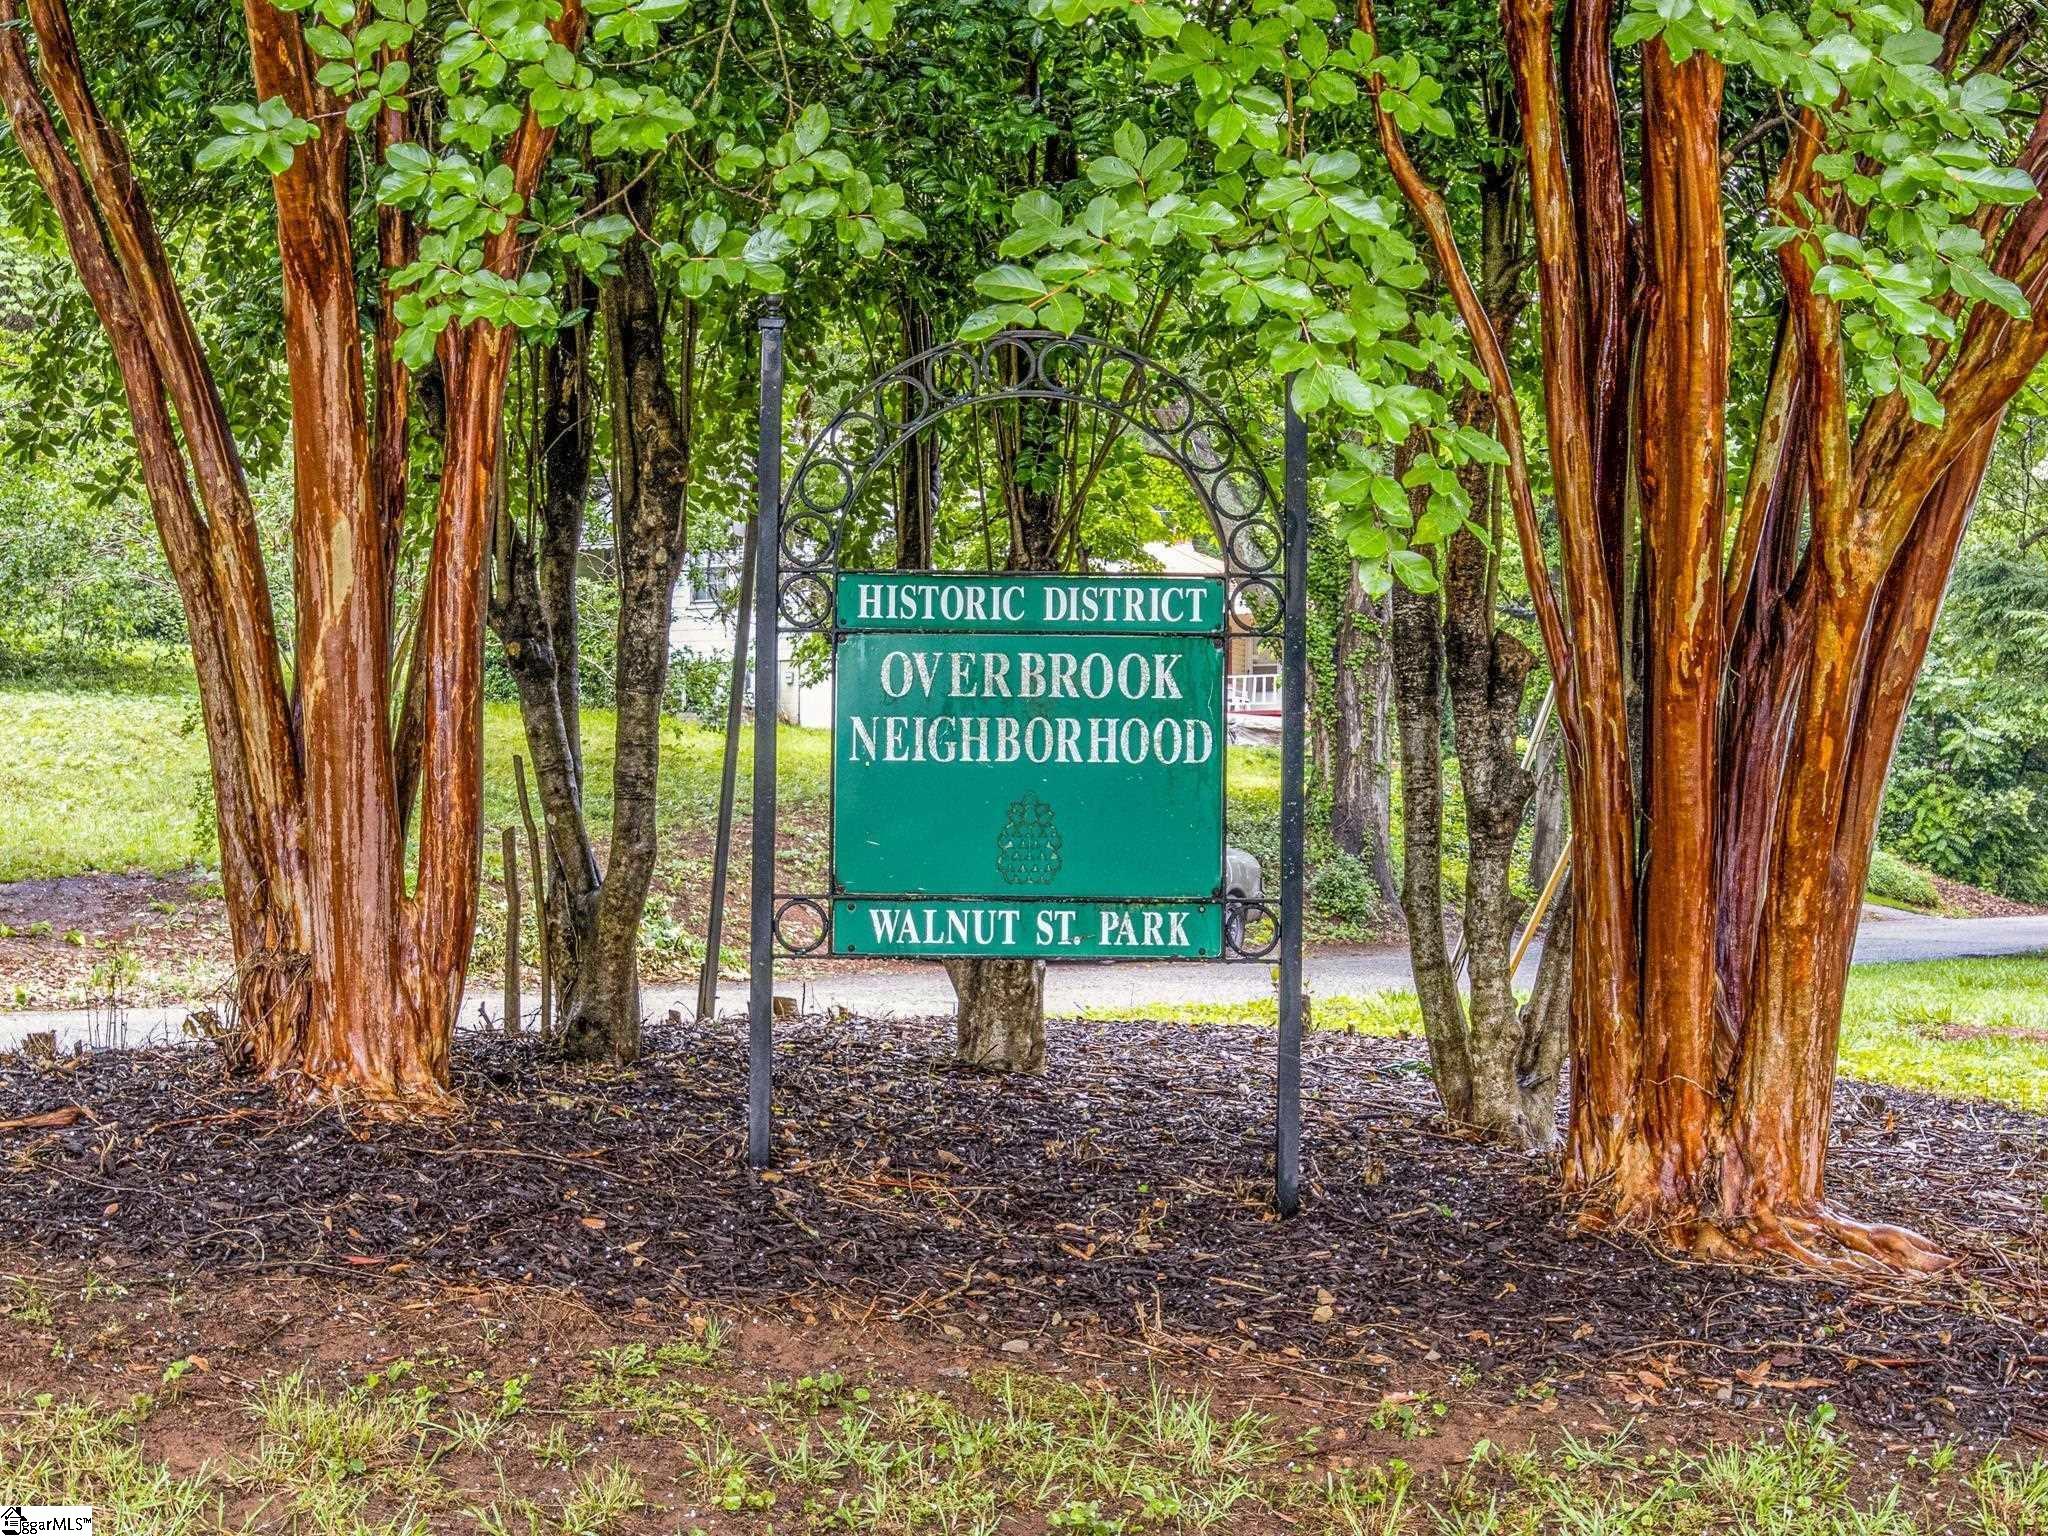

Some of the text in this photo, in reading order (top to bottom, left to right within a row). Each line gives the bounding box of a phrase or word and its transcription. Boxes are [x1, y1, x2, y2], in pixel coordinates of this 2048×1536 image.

[857, 584, 1208, 623] HISTORIC DISTRICT
[880, 650, 1184, 700] OVERBROOK
[849, 715, 1213, 765] NEIGHBORHOOD
[869, 909, 1191, 947] WALNUT ST. PARK
